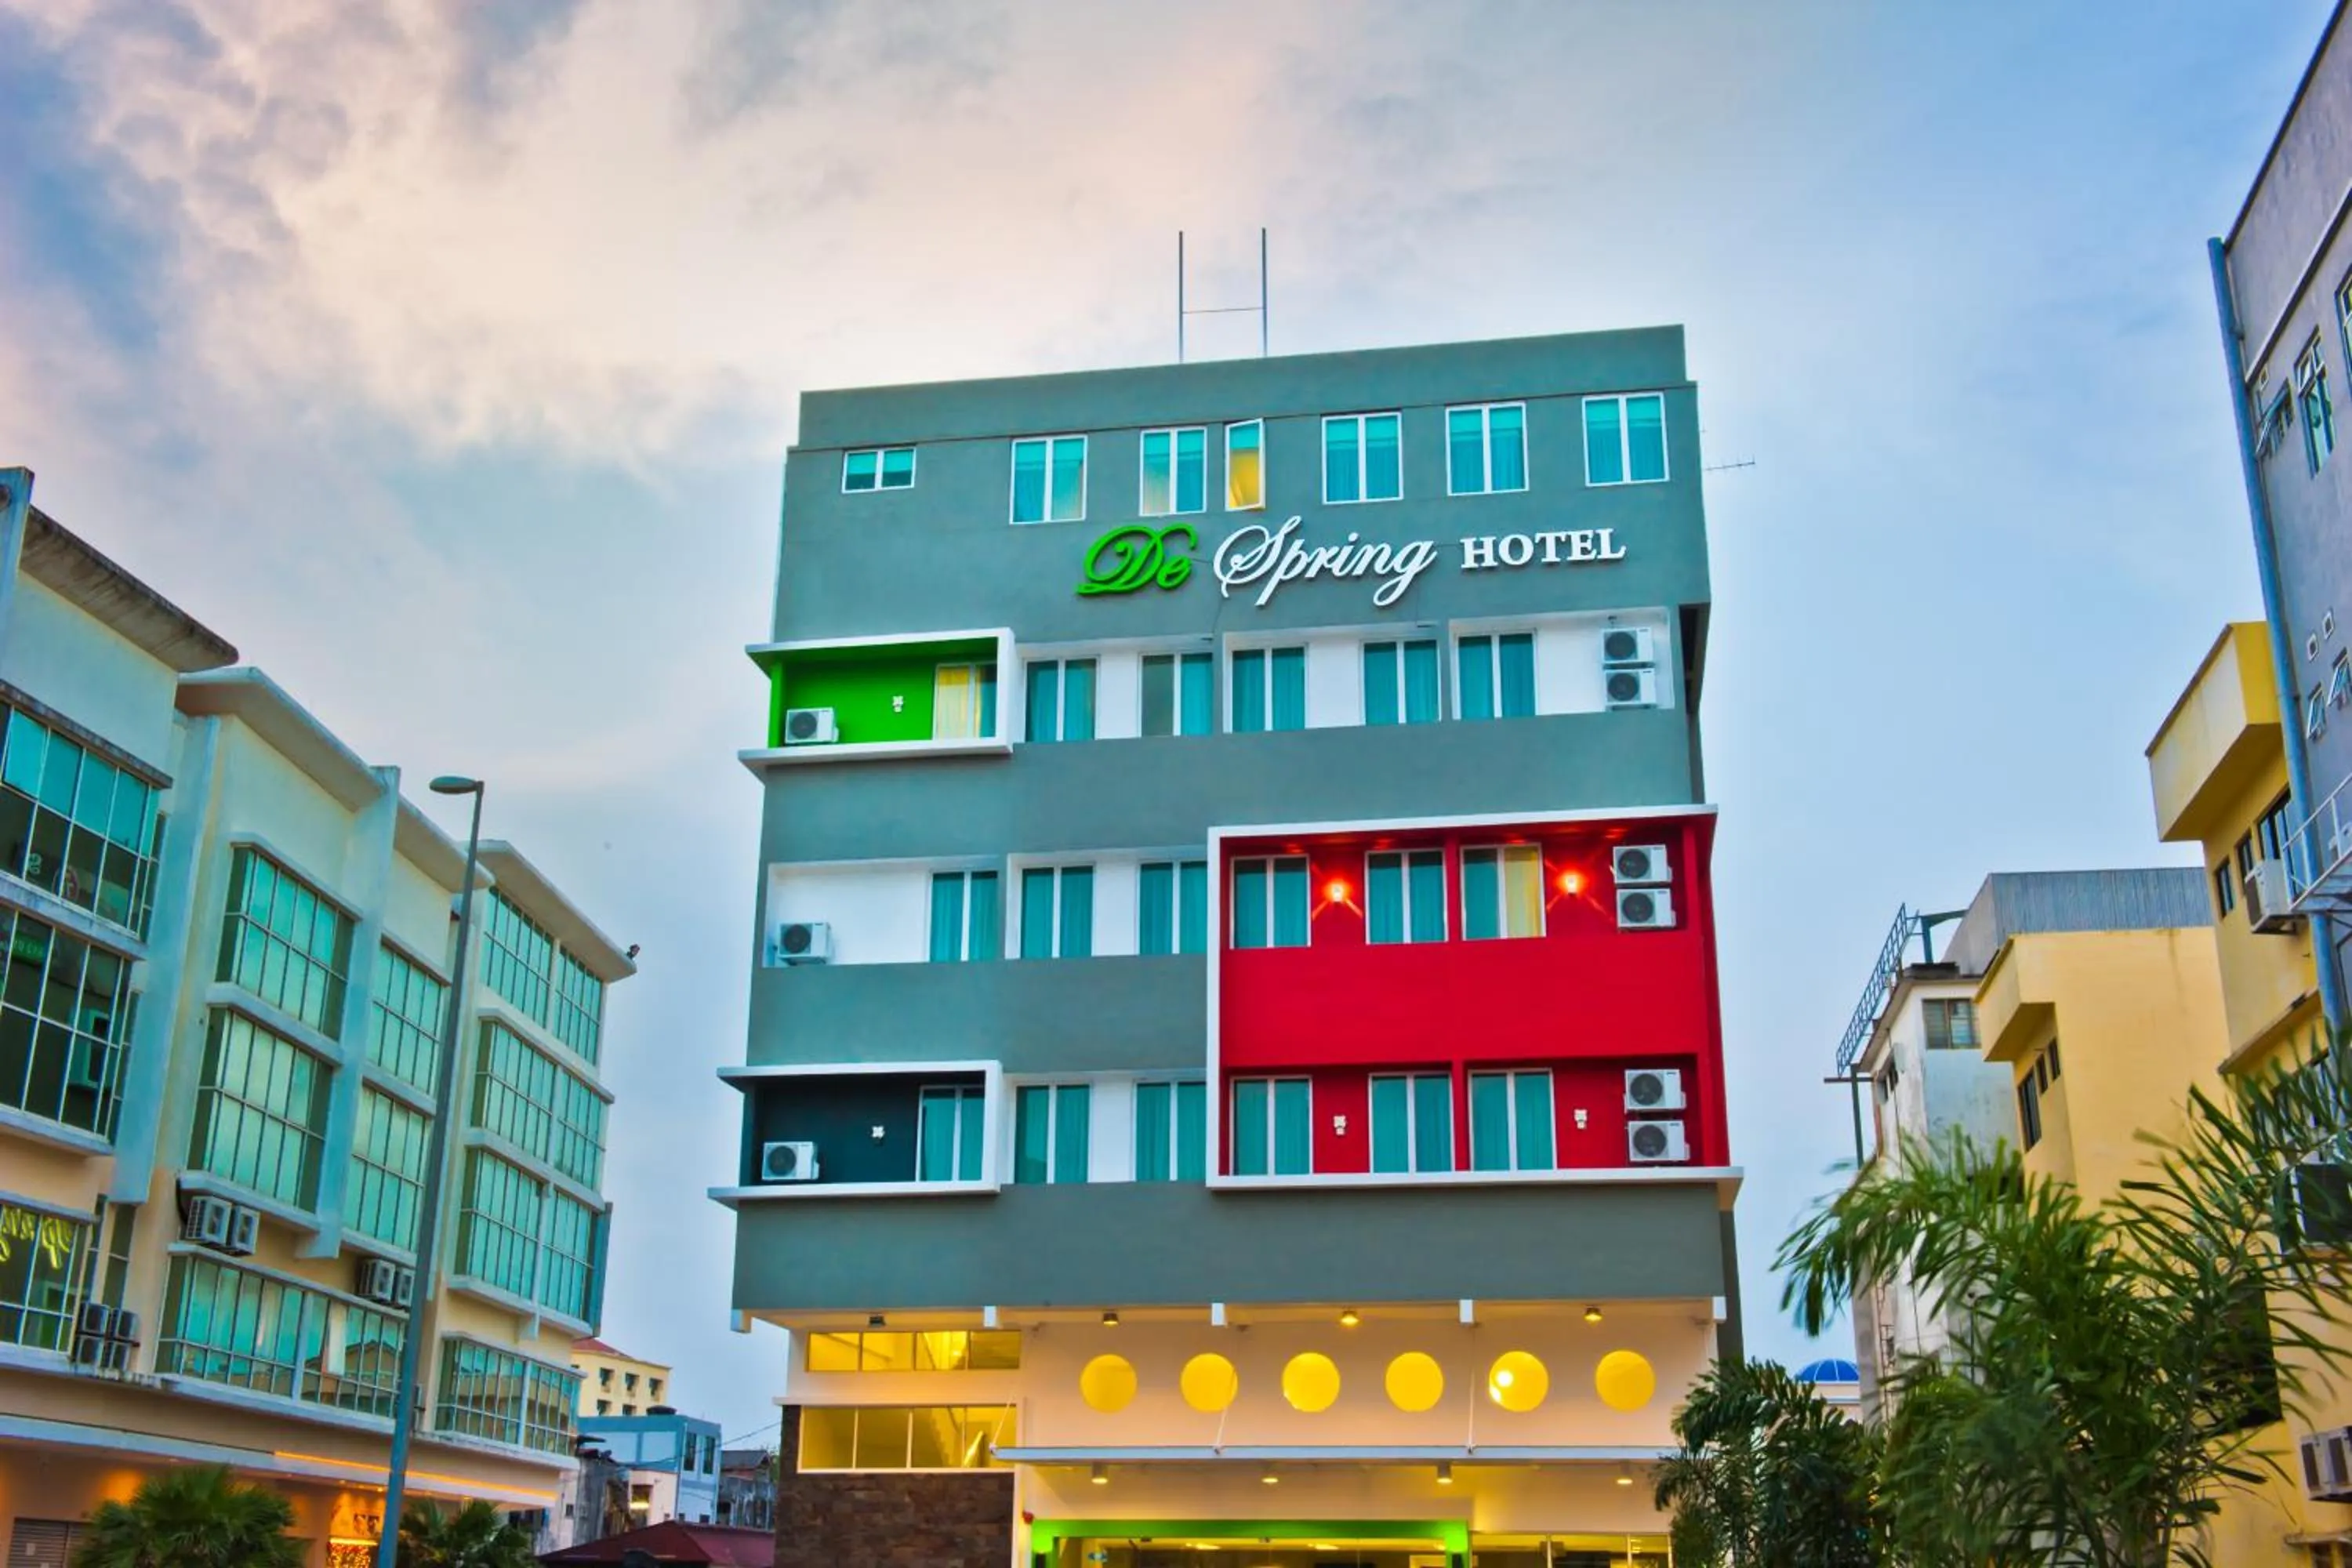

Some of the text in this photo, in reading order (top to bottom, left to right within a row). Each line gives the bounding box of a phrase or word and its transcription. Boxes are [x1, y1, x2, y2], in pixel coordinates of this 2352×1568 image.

[1077, 515, 1626, 607] De Spring HOTEL
